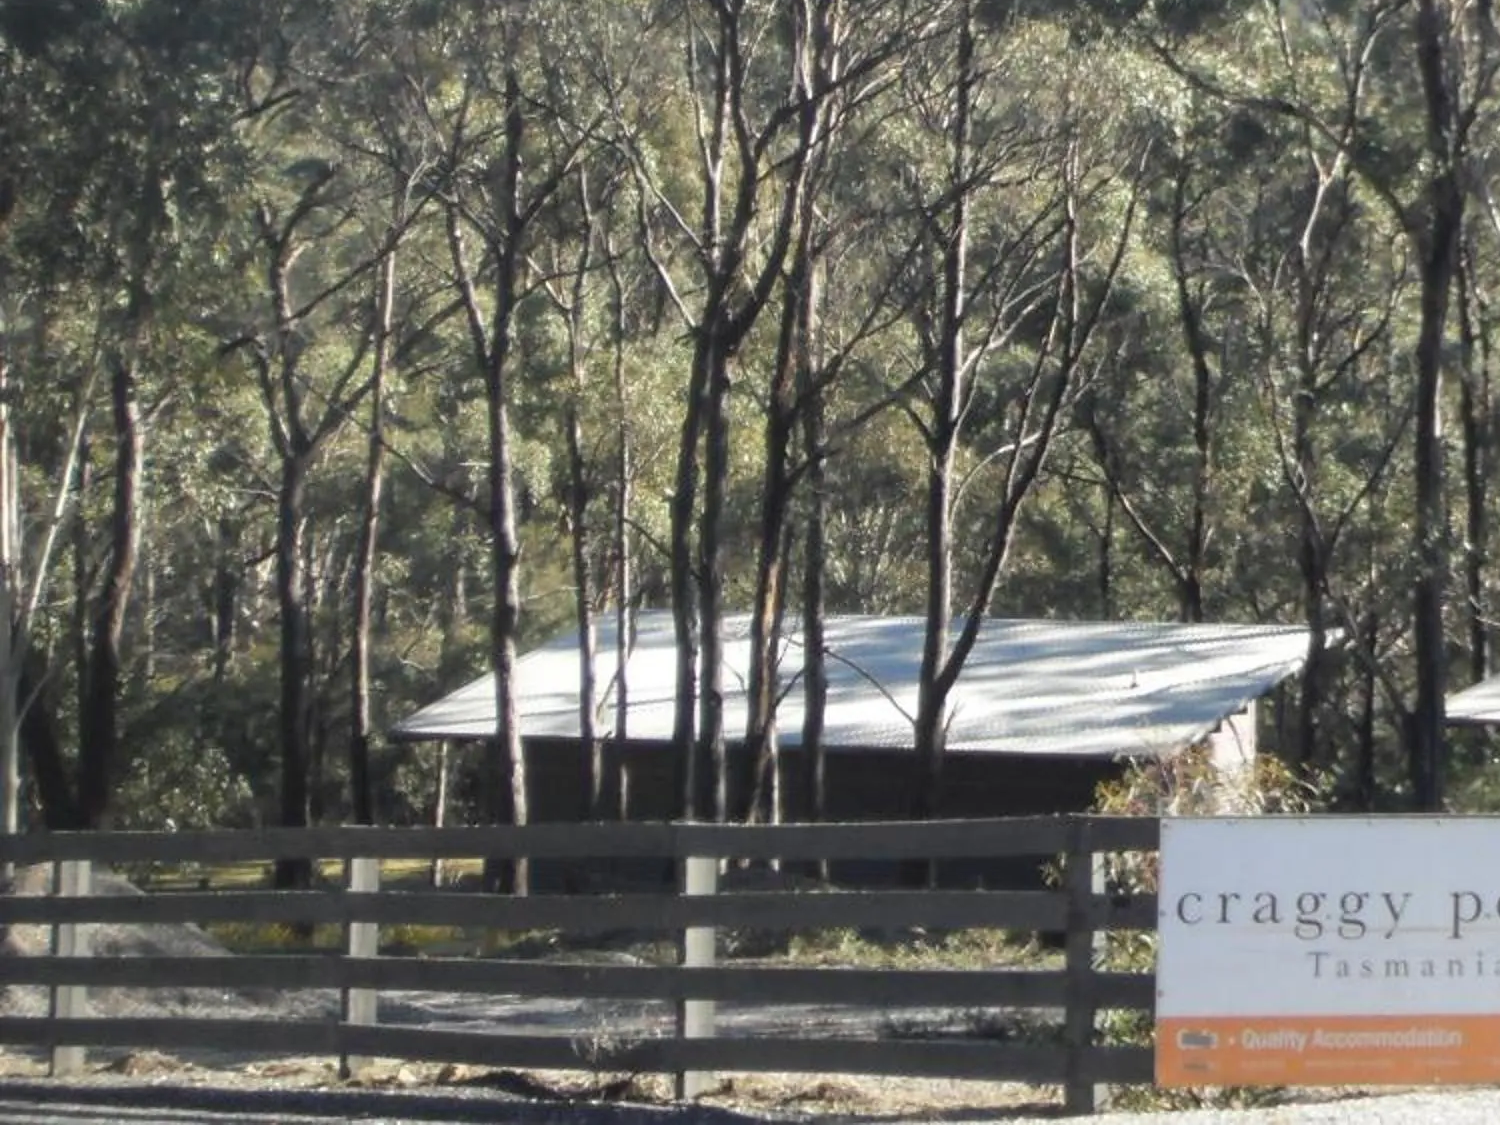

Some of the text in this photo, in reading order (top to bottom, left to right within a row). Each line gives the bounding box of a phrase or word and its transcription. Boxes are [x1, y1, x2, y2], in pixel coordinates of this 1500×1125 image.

[1175, 889, 1411, 940] craggy
[1241, 1028, 1306, 1052] Quality
[1311, 1027, 1463, 1049] Accommodation
